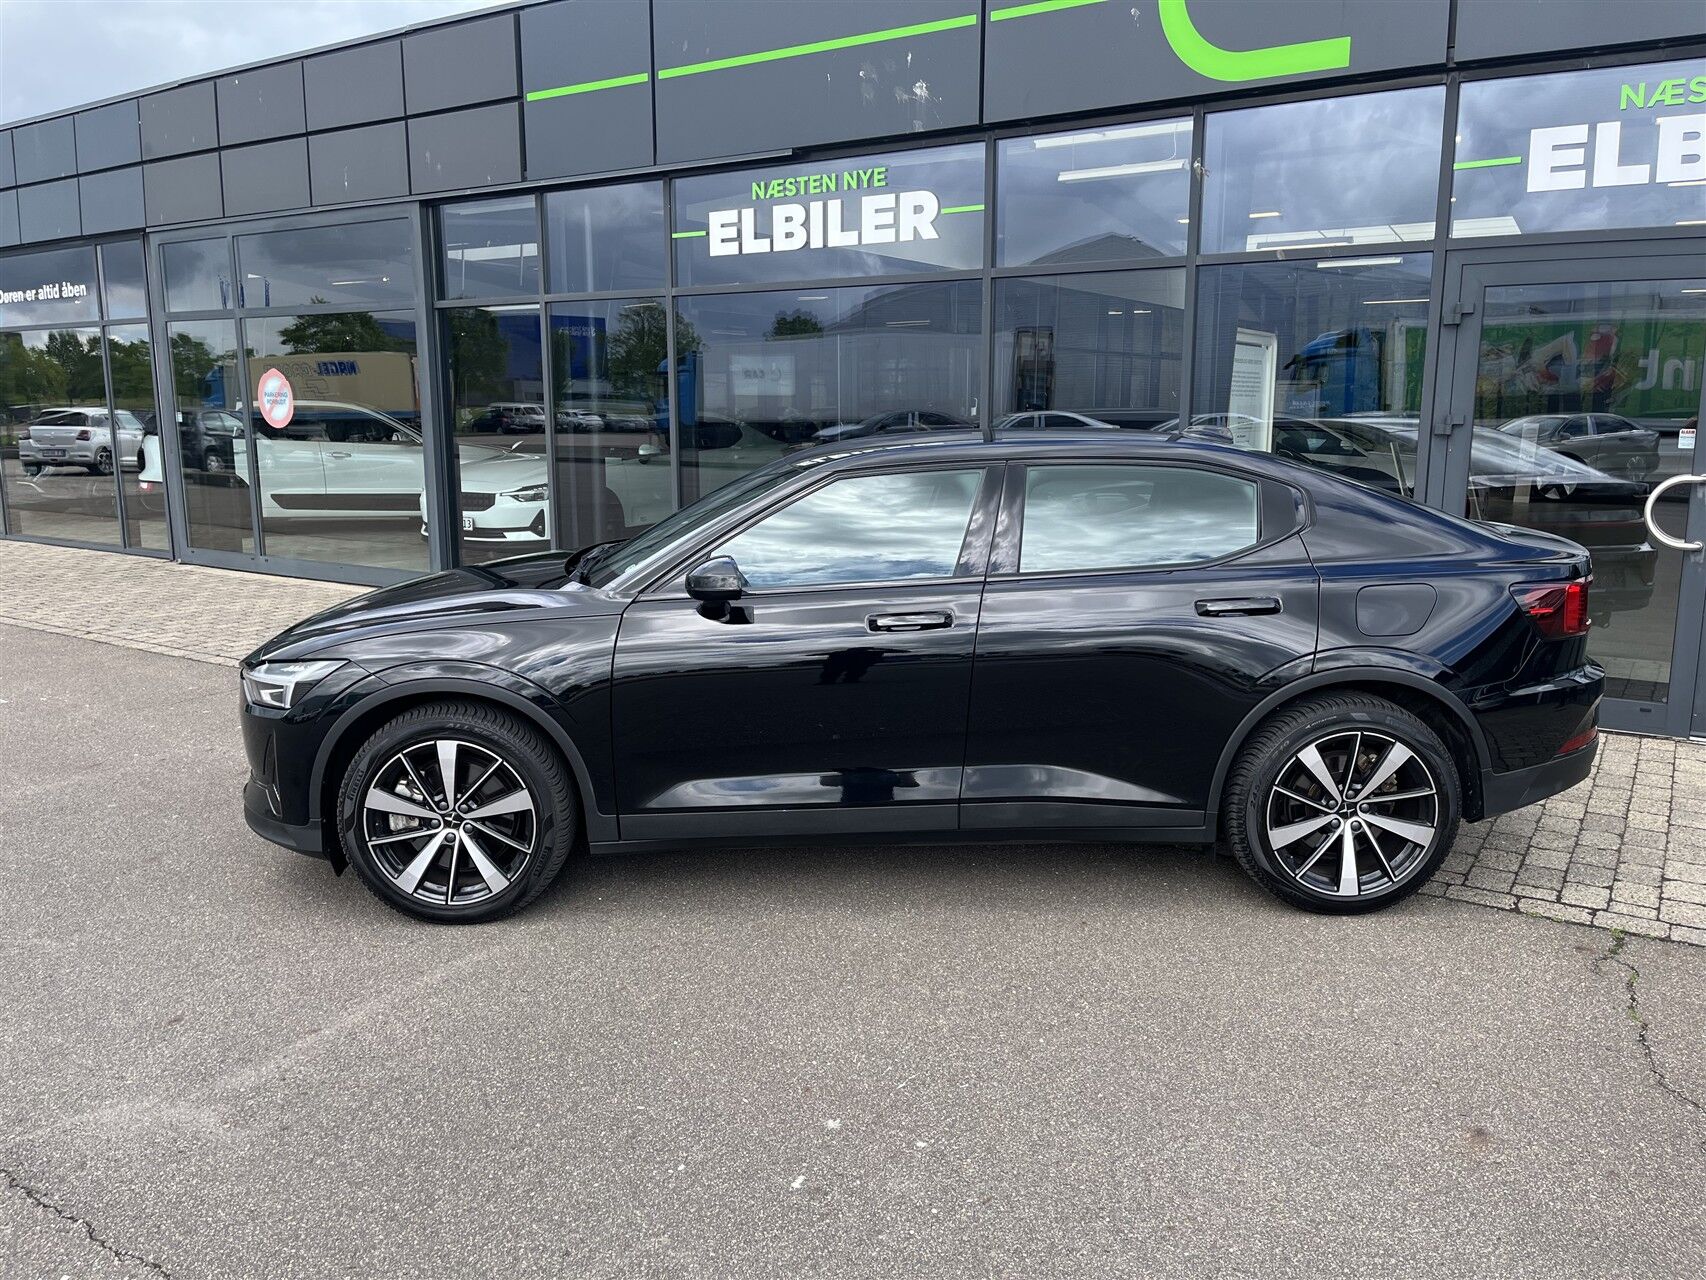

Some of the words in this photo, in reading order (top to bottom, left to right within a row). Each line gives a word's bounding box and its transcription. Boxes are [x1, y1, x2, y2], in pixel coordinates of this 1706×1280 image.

[1527, 114, 1706, 193] ELB
[752, 173, 837, 201] NÆSTEN
[843, 167, 888, 191] NYE
[708, 190, 940, 257] ELBILER
[25, 289, 36, 301] er
[38, 284, 59, 300] altid
[61, 281, 86, 298] åben
